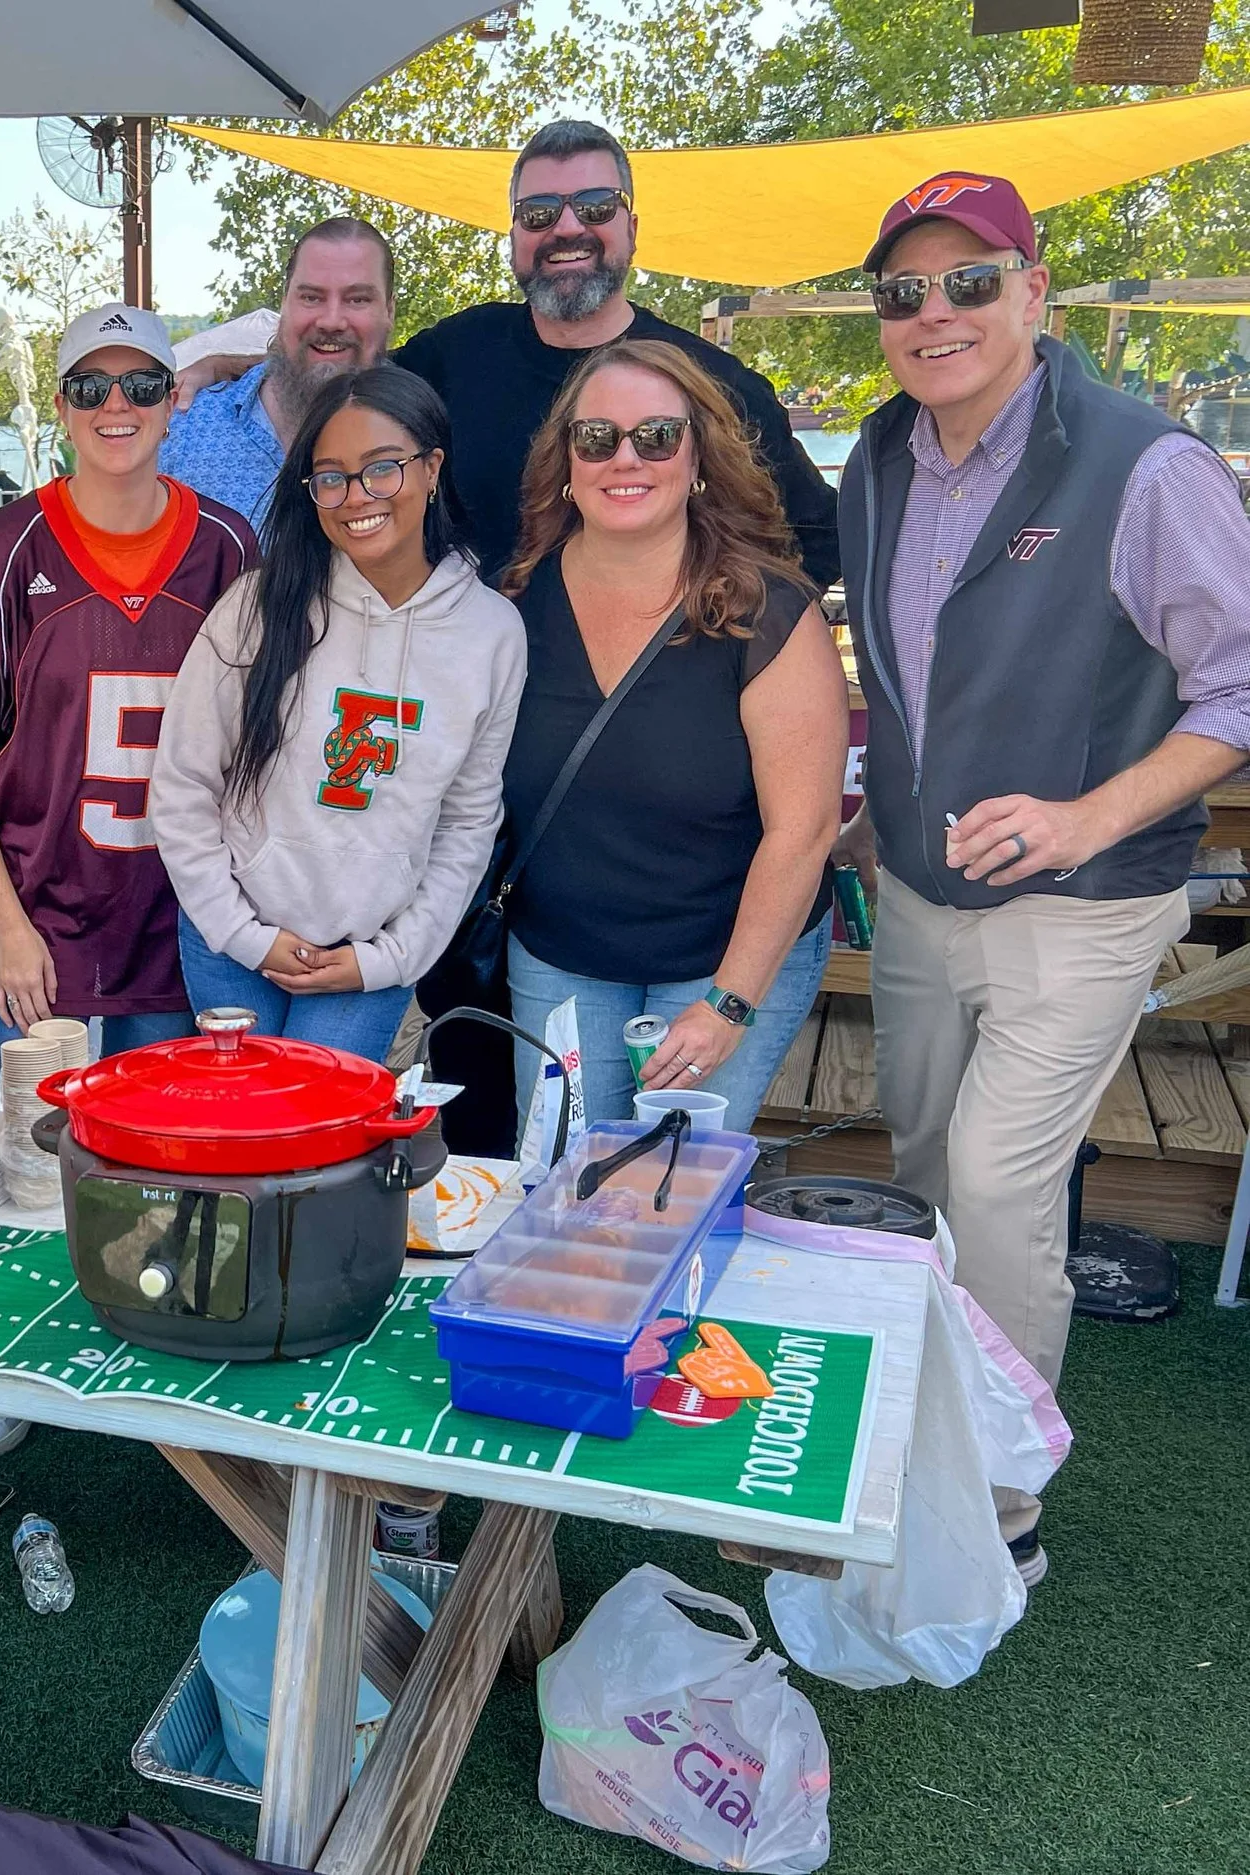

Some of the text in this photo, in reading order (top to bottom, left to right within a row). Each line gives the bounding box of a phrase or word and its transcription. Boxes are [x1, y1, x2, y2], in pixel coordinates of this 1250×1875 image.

[904, 178, 992, 214] VT
[99, 323, 133, 333] adidas
[1006, 528, 1060, 560] VT
[27, 584, 57, 596] adidas
[123, 596, 145, 609] VT
[79, 671, 181, 852] 5
[68, 1347, 136, 1377] 20
[300, 1391, 361, 1417] 10
[736, 1331, 827, 1496] TOUCHDOWN
[391, 1528, 417, 1538] Sterno
[595, 1769, 634, 1808] REDUCE
[649, 1817, 682, 1852] REUSE
